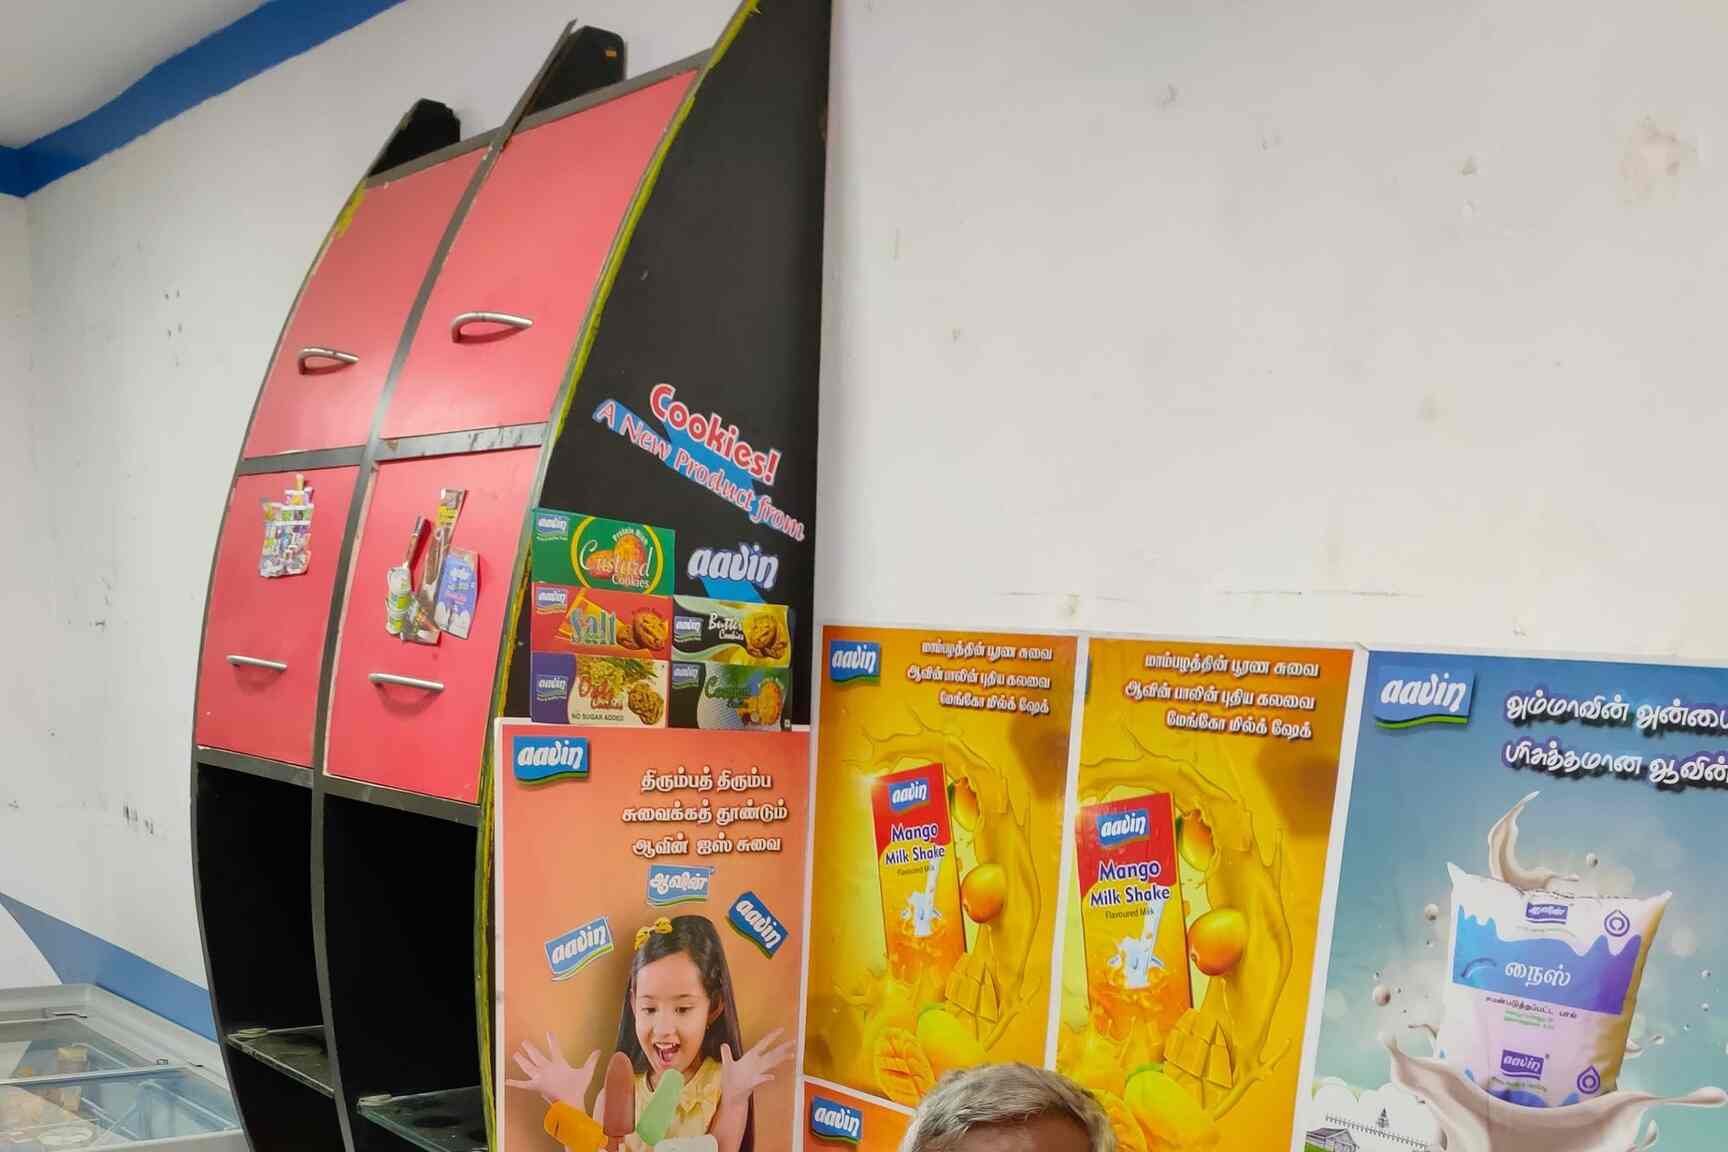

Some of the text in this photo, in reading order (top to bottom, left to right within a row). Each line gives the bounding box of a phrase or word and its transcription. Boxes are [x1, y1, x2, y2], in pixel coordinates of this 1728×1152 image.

[649, 383, 781, 486] Cookies!
[596, 399, 806, 543] A New Product from
[688, 543, 779, 590] aavin
[569, 608, 617, 645] Salt
[832, 643, 877, 674] aavin
[1145, 651, 1320, 678] மாம்பழத்தின் பூரண சுவை
[1125, 680, 1315, 710] ஆவின் பாலின் புதிய கலவை
[1380, 673, 1466, 712] aavin
[1506, 688, 1630, 721] அம்மாவின்
[1167, 710, 1225, 731] மேங்கோ
[1229, 716, 1267, 734] மில்க்
[517, 740, 584, 769] aavin
[1505, 740, 1643, 775] பரிசுத்தமான
[641, 766, 772, 792] திரும்பத் திரும்ப
[891, 781, 928, 805] aavin
[621, 798, 788, 825] சுவைக்கத் தூண்டும்
[891, 823, 939, 844] Mango
[1100, 813, 1147, 838] aavin
[632, 831, 782, 858] ஆவின் ஐஸ் சுவை
[885, 843, 946, 866] Milk Shake
[650, 869, 709, 894] ஆவின்
[1098, 860, 1161, 884] Mango
[1090, 884, 1171, 907] Milk Shake
[1504, 961, 1571, 987] நைஸ்
[814, 1107, 859, 1136] aavin
